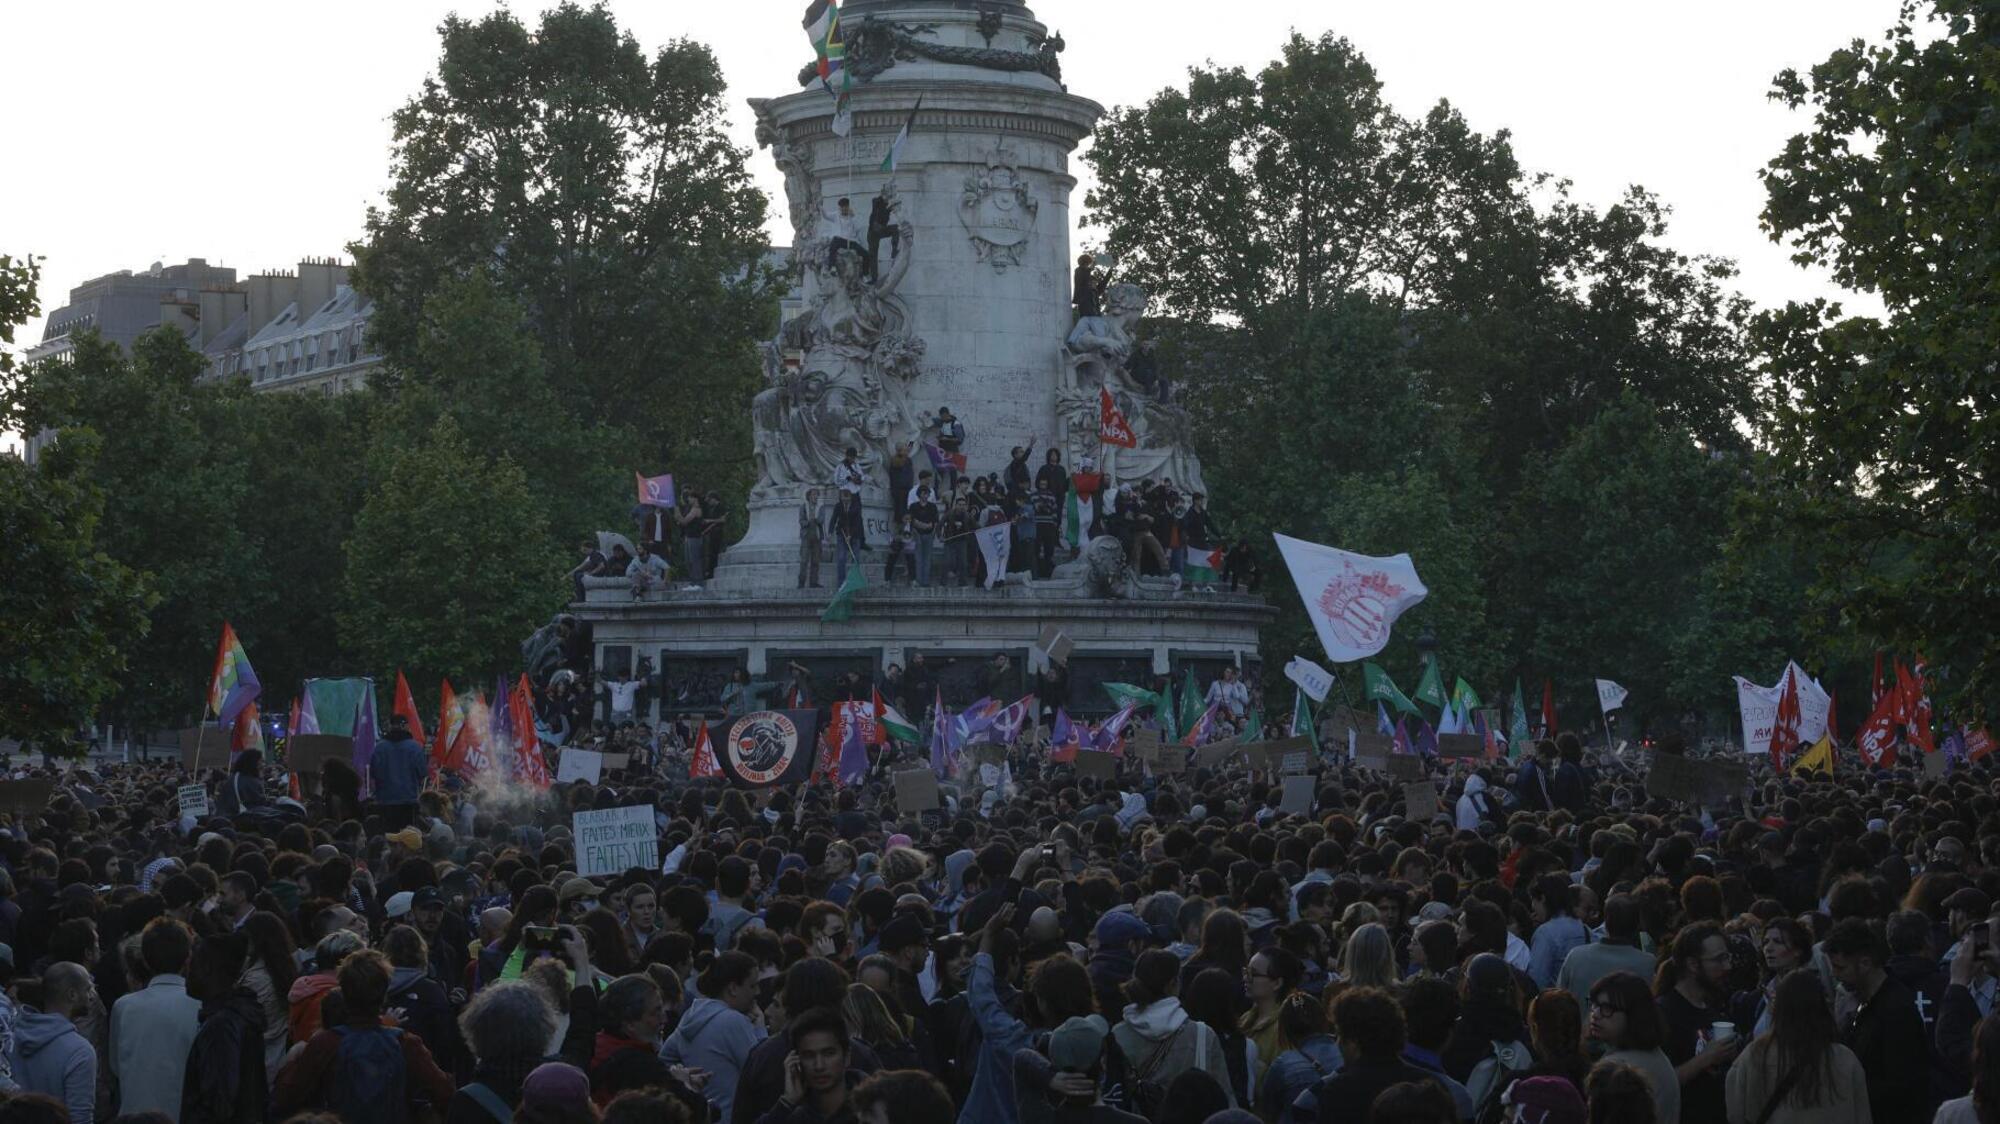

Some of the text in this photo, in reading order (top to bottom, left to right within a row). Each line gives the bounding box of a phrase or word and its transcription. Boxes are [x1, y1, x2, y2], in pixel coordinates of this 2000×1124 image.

[1102, 423, 1129, 441] NPA
[1861, 728, 1885, 763] NPA
[582, 821, 650, 845] FAITES MIEUX
[586, 840, 658, 873] FAITES VITE
